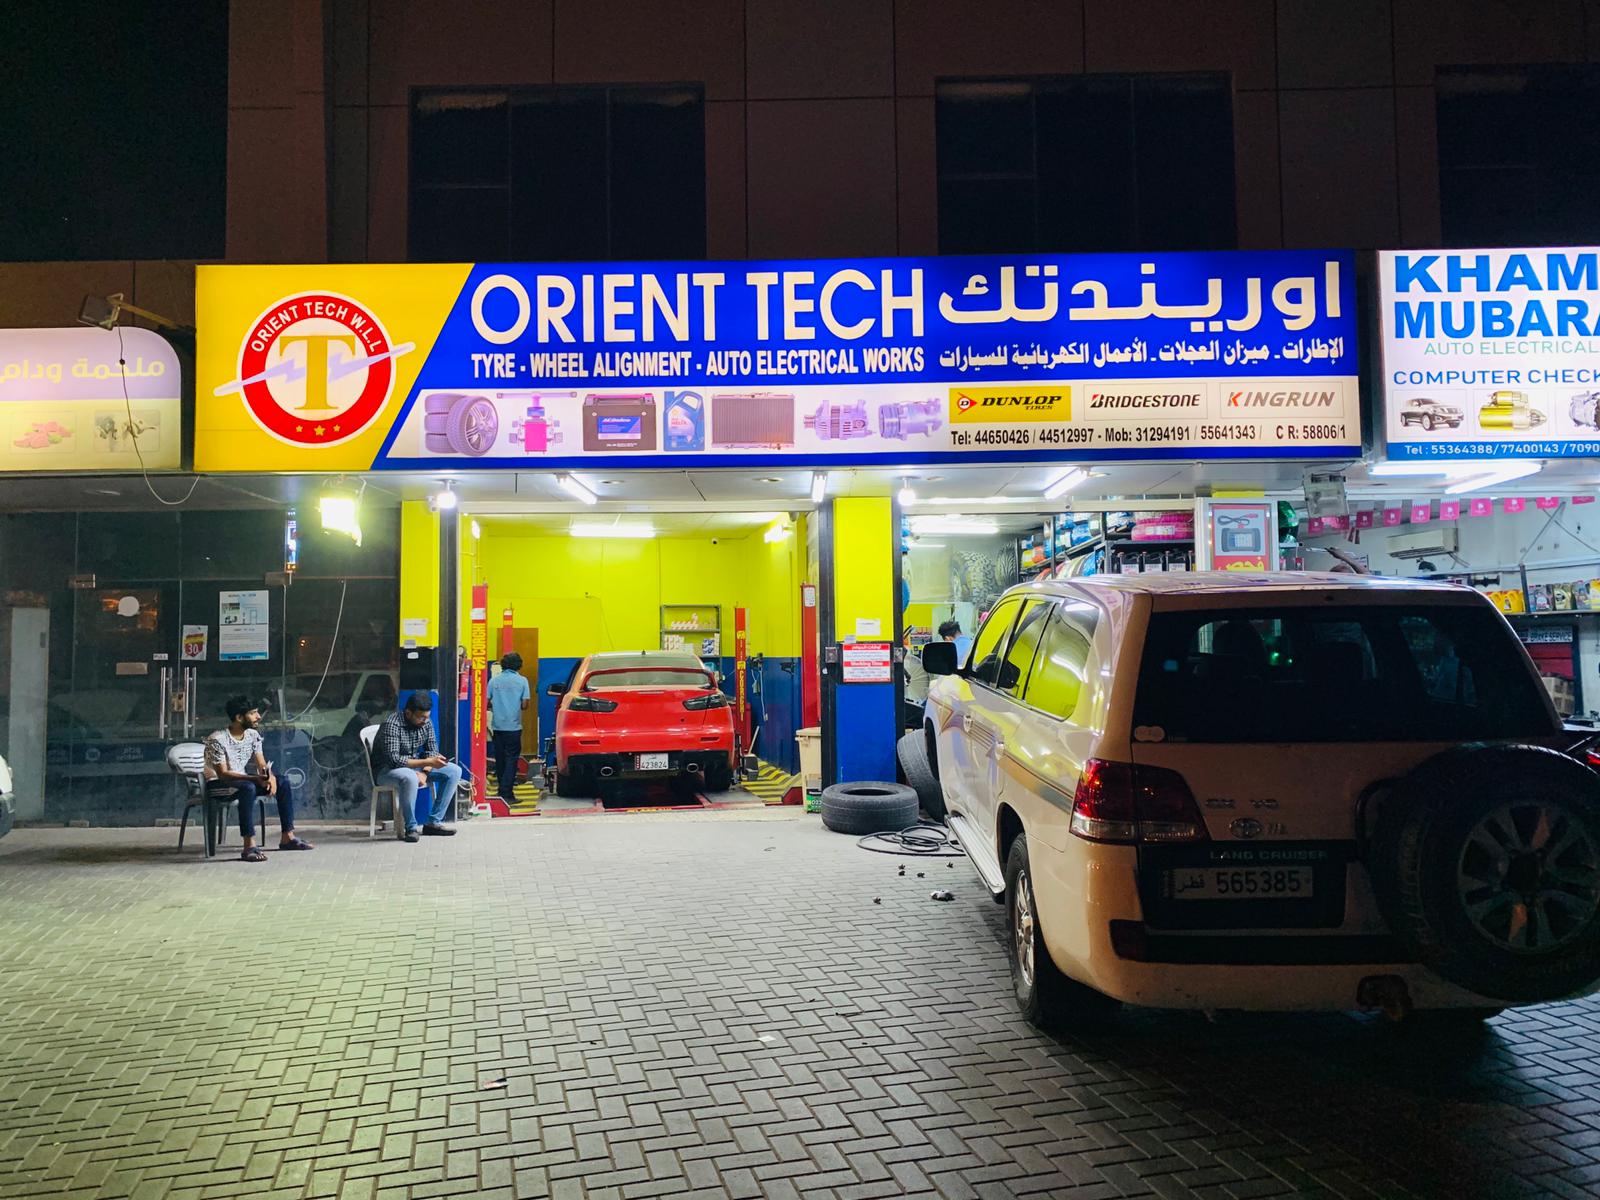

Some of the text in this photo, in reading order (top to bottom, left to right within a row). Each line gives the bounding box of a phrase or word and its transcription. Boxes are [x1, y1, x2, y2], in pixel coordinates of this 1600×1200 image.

[1394, 253, 1598, 293] KHAM
[470, 268, 925, 345] ORIENT TECH
[1394, 299, 1600, 339] MUBAR
[251, 301, 382, 353] ORIENT TECH W.L.L
[939, 345, 1008, 372] للسيارات
[1011, 341, 1089, 370] الكهربائية
[1093, 336, 1147, 368] الأعمال
[1158, 339, 1220, 365] العجلات
[1223, 339, 1270, 365] ميزان
[1282, 336, 1344, 365] الإطارات
[1424, 340, 1599, 356] AUTO ELECTRICAL
[279, 335, 356, 410] T
[471, 353, 516, 378] TYRE
[529, 352, 589, 378] WHEEL
[593, 351, 692, 377] ALIGNMENT
[706, 350, 753, 376] AUTO
[756, 348, 861, 375] ELECTRICAL
[863, 346, 925, 373] WORKS
[1393, 370, 1521, 385] COMPUTER
[981, 395, 1062, 407] DUNLOP
[1090, 393, 1201, 409] BRIDGESTONE
[1227, 391, 1336, 407] KINGRUN
[951, 430, 971, 445] Tel:
[974, 429, 1030, 445] 44650426
[1039, 428, 1094, 444] 44512997
[1105, 427, 1132, 442] Mob:
[1135, 426, 1190, 442] 31294191
[1200, 425, 1256, 440] 55641343
[1276, 425, 1284, 439] C
[1288, 424, 1299, 439] R:
[1302, 424, 1346, 439] 58806/1
[1501, 443, 1559, 454] 77400143
[472, 623, 487, 656] CORGHI
[641, 761, 668, 770] 423824
[1209, 849, 1328, 860] LAND CRUISER
[1216, 870, 1301, 894] 565385
